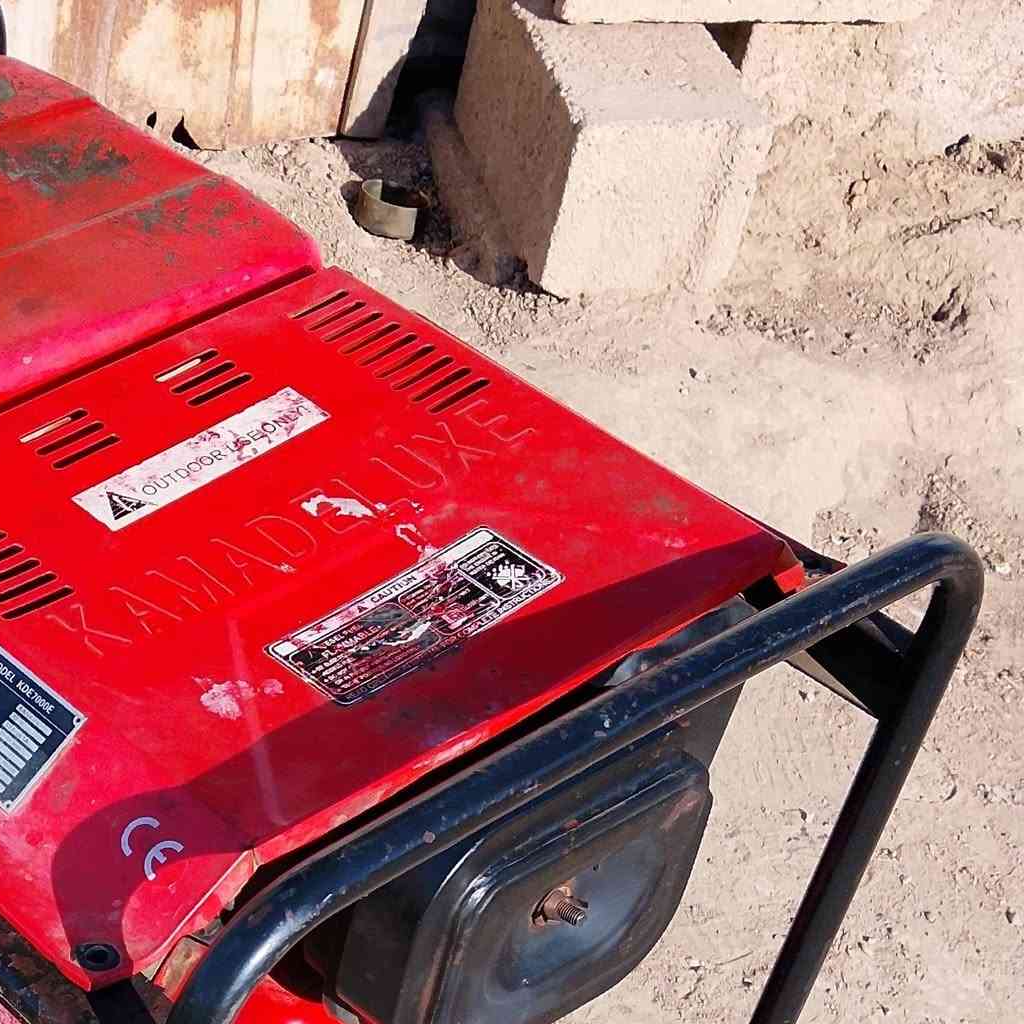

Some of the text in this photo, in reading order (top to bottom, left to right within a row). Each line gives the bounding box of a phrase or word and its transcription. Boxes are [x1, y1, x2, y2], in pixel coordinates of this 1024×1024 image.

[141, 447, 227, 496] OUTDOOR
[16, 680, 55, 715] KDE7000E
[121, 816, 184, 880] CE
